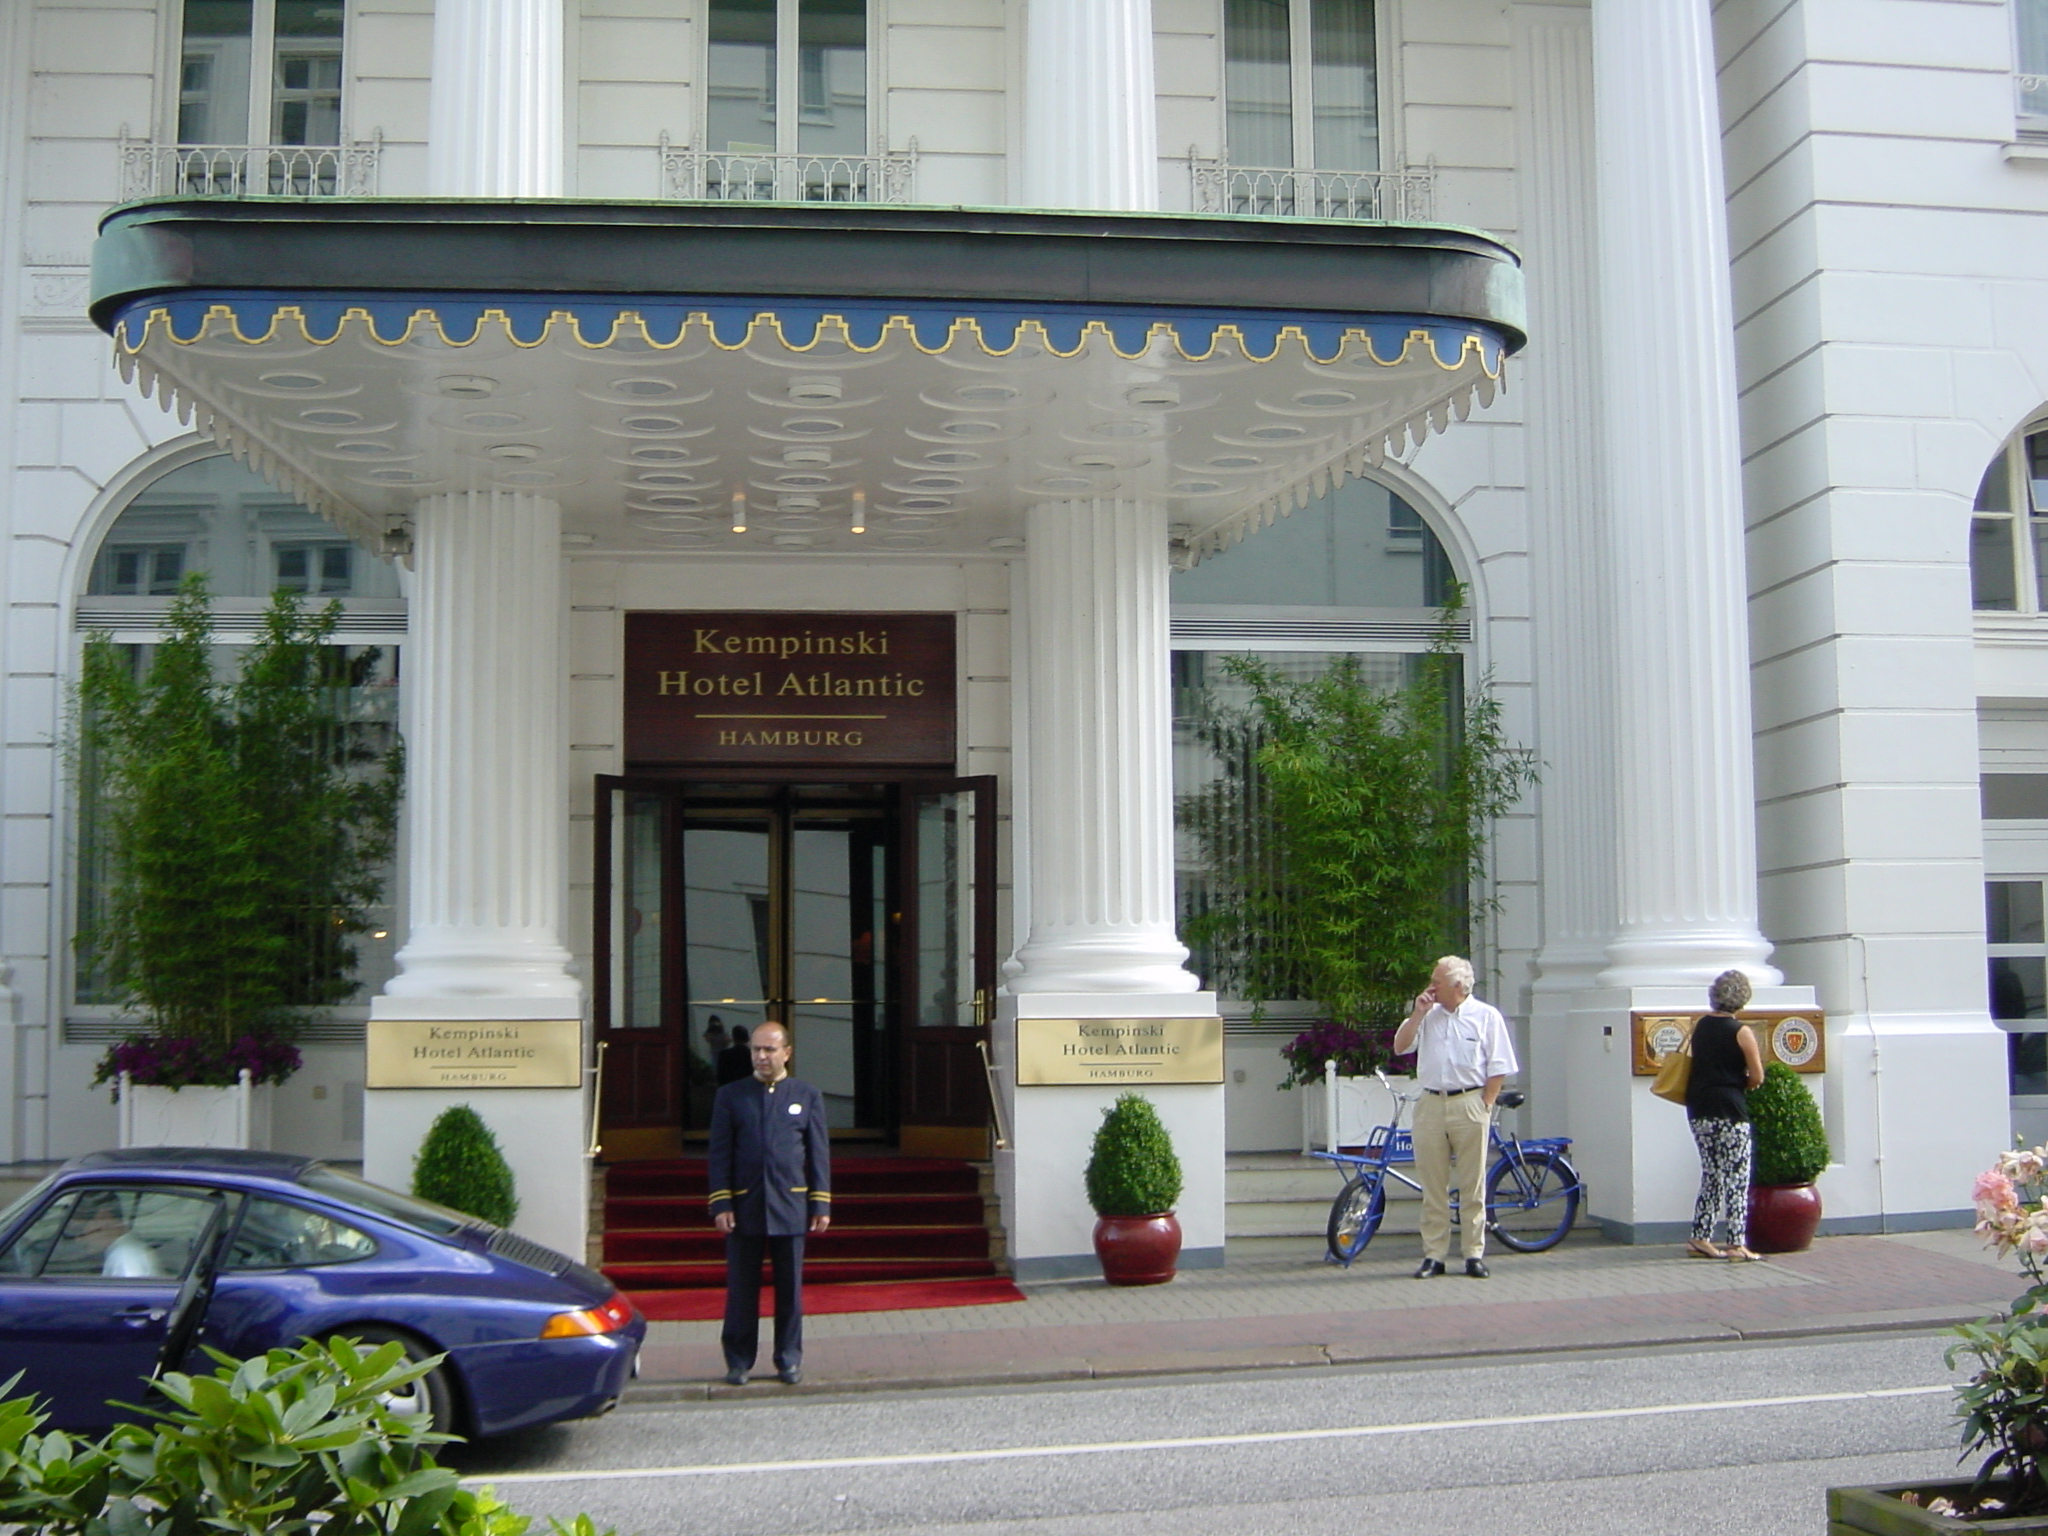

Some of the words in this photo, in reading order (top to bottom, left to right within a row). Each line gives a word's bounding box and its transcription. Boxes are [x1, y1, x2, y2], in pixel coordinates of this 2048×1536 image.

[693, 628, 889, 660] Kempinski
[658, 670, 763, 696] Hotel
[778, 672, 924, 697] Atlantic
[720, 731, 864, 746] HAMBURG
[429, 1026, 519, 1042] Kempinski
[1078, 1025, 1164, 1039] Kempinski
[413, 1046, 461, 1058] Hotel
[467, 1046, 536, 1058] Atlantic
[1063, 1044, 1109, 1056] Hotel
[1115, 1044, 1181, 1056] Atlantic
[441, 1073, 507, 1081] HAMBURG
[1089, 1070, 1154, 1078] HAMBURG
